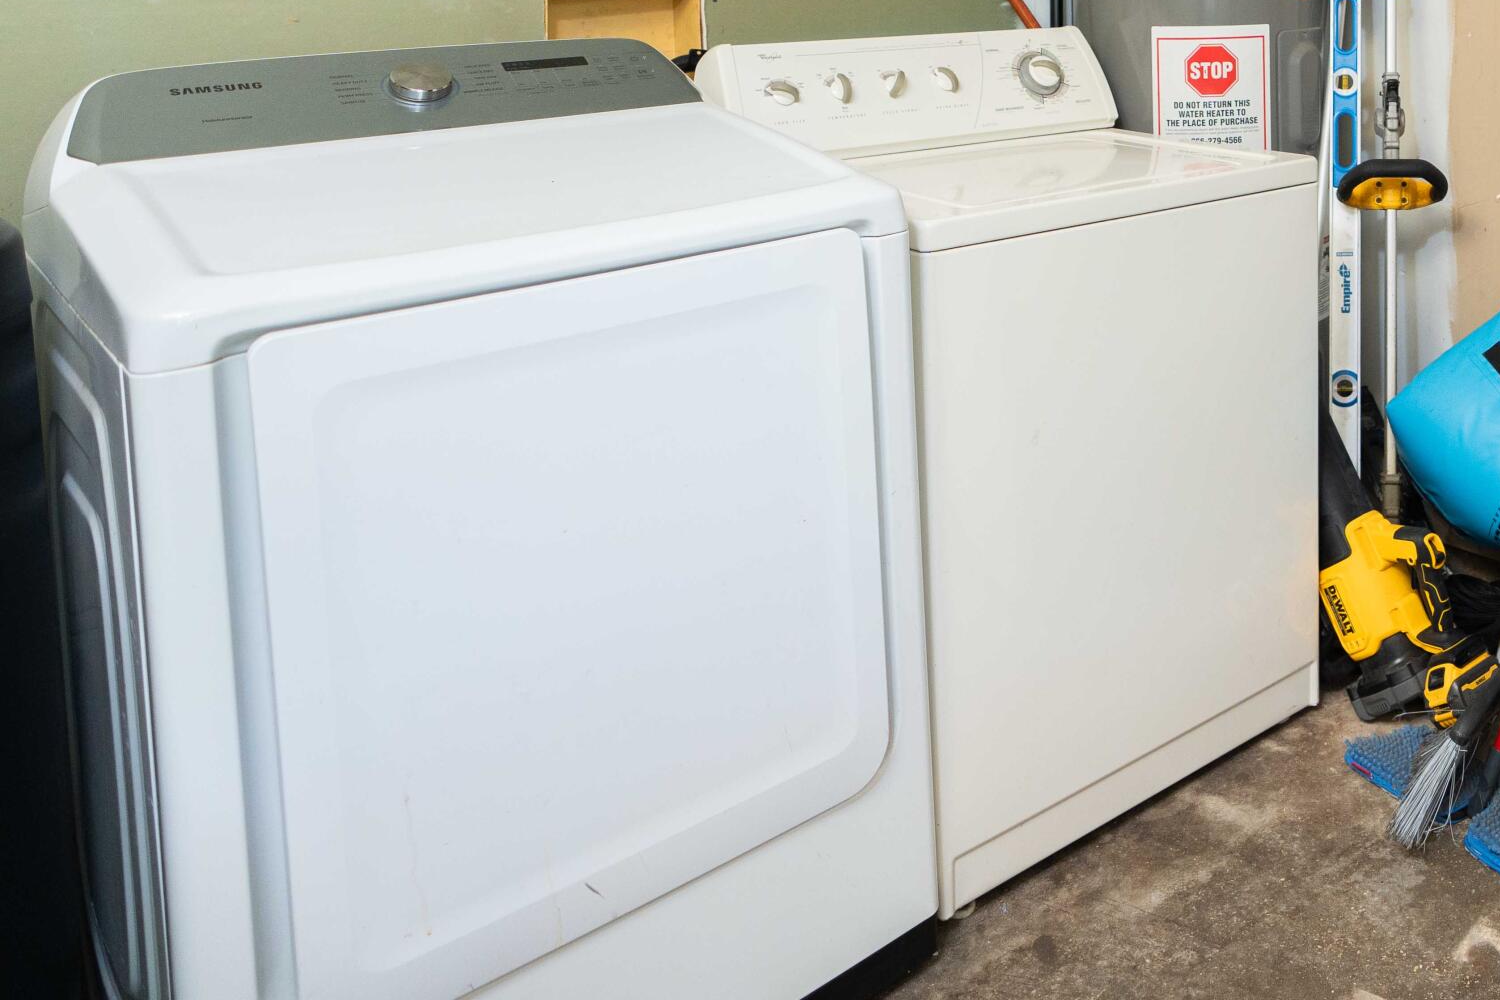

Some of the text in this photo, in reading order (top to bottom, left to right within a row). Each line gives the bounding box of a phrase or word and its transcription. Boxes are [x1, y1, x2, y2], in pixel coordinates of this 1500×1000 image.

[1189, 61, 1234, 80] STOP
[169, 82, 264, 97] SAMSUNG
[1173, 99, 1251, 109] DO NOT RETURN THIS
[1178, 108, 1246, 118] WATER HEATER TO
[1166, 116, 1259, 127] THE PLACE OF PURCHASE
[1340, 270, 1353, 314] Empire
[1327, 584, 1355, 635] DEWALT
